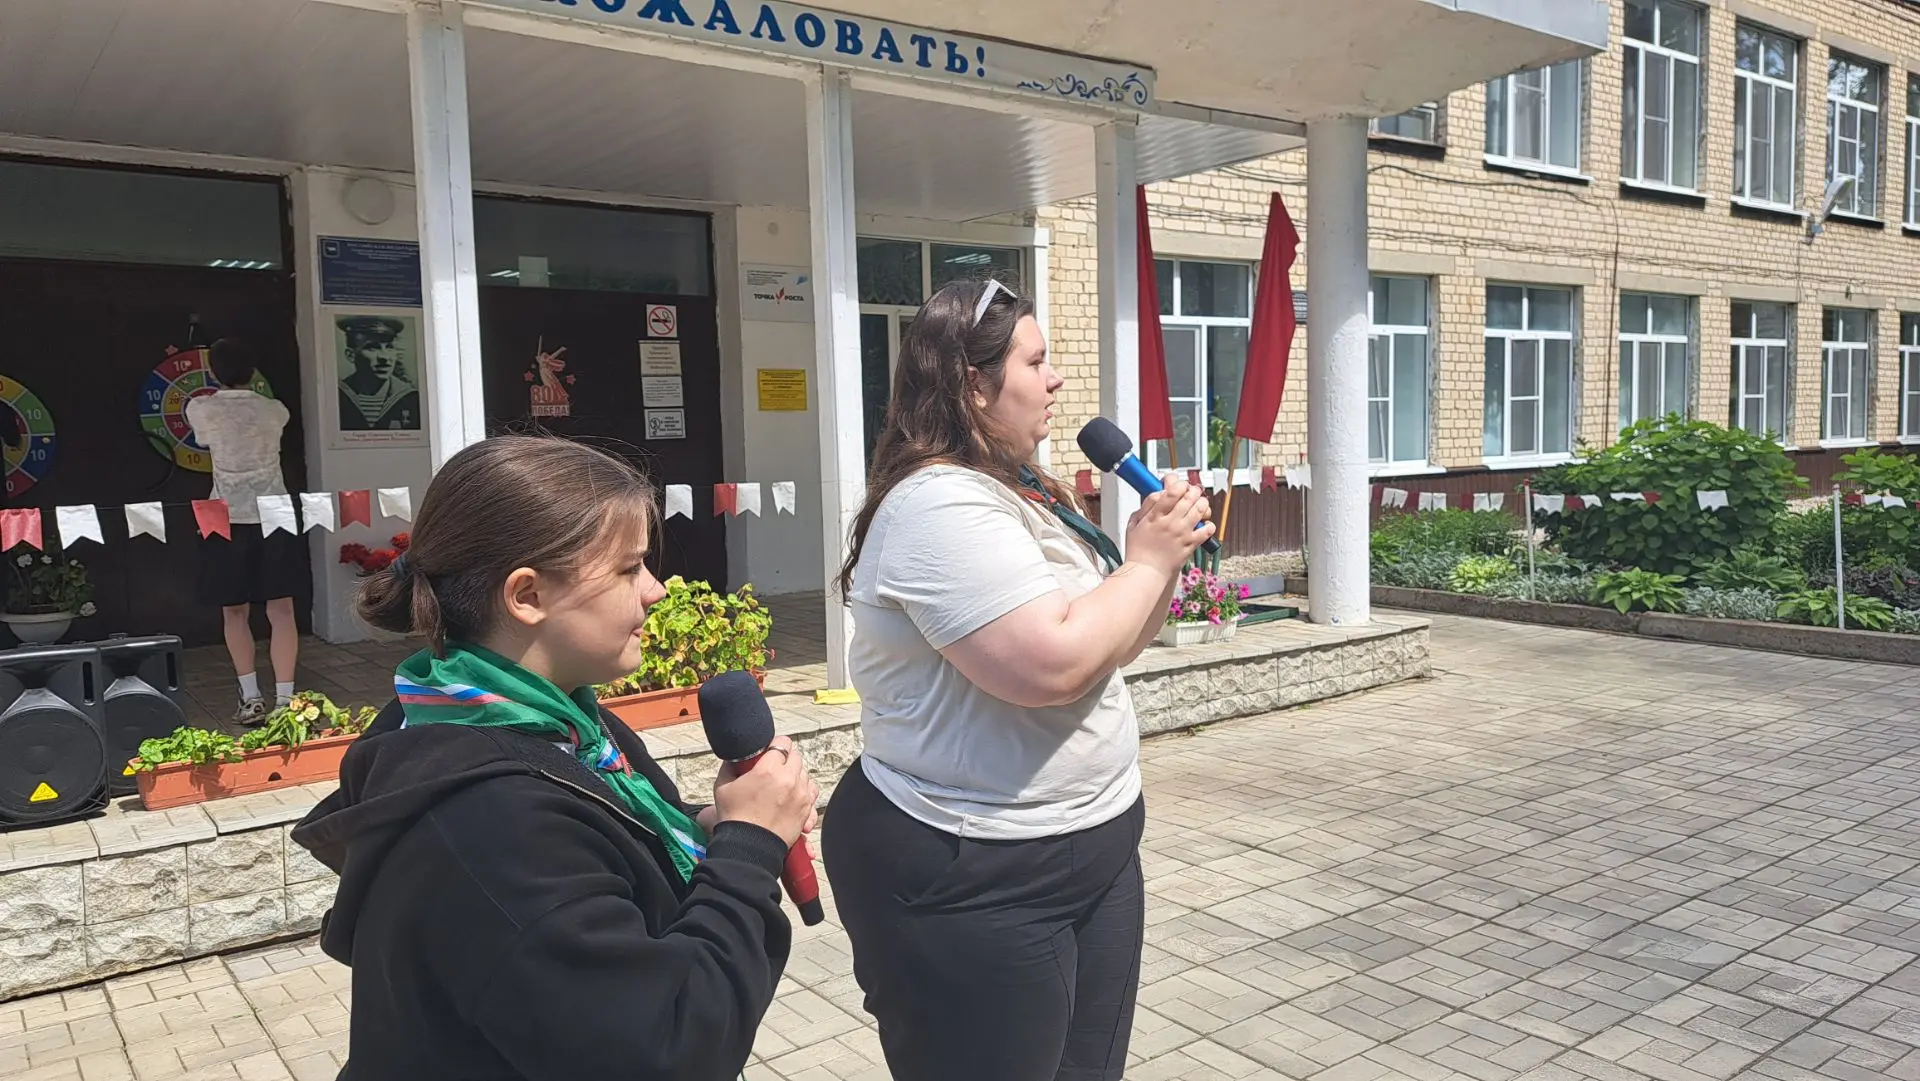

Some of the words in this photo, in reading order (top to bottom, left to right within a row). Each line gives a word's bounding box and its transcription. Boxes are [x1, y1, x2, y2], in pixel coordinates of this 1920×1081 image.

[541, 0, 985, 77] ЖАЛОВАТЬ!
[754, 293, 775, 301] ТОЧКА
[173, 360, 187, 372] 10
[146, 389, 161, 401] 10
[27, 408, 41, 420] 10
[30, 449, 46, 461] 10
[186, 454, 200, 465] 10
